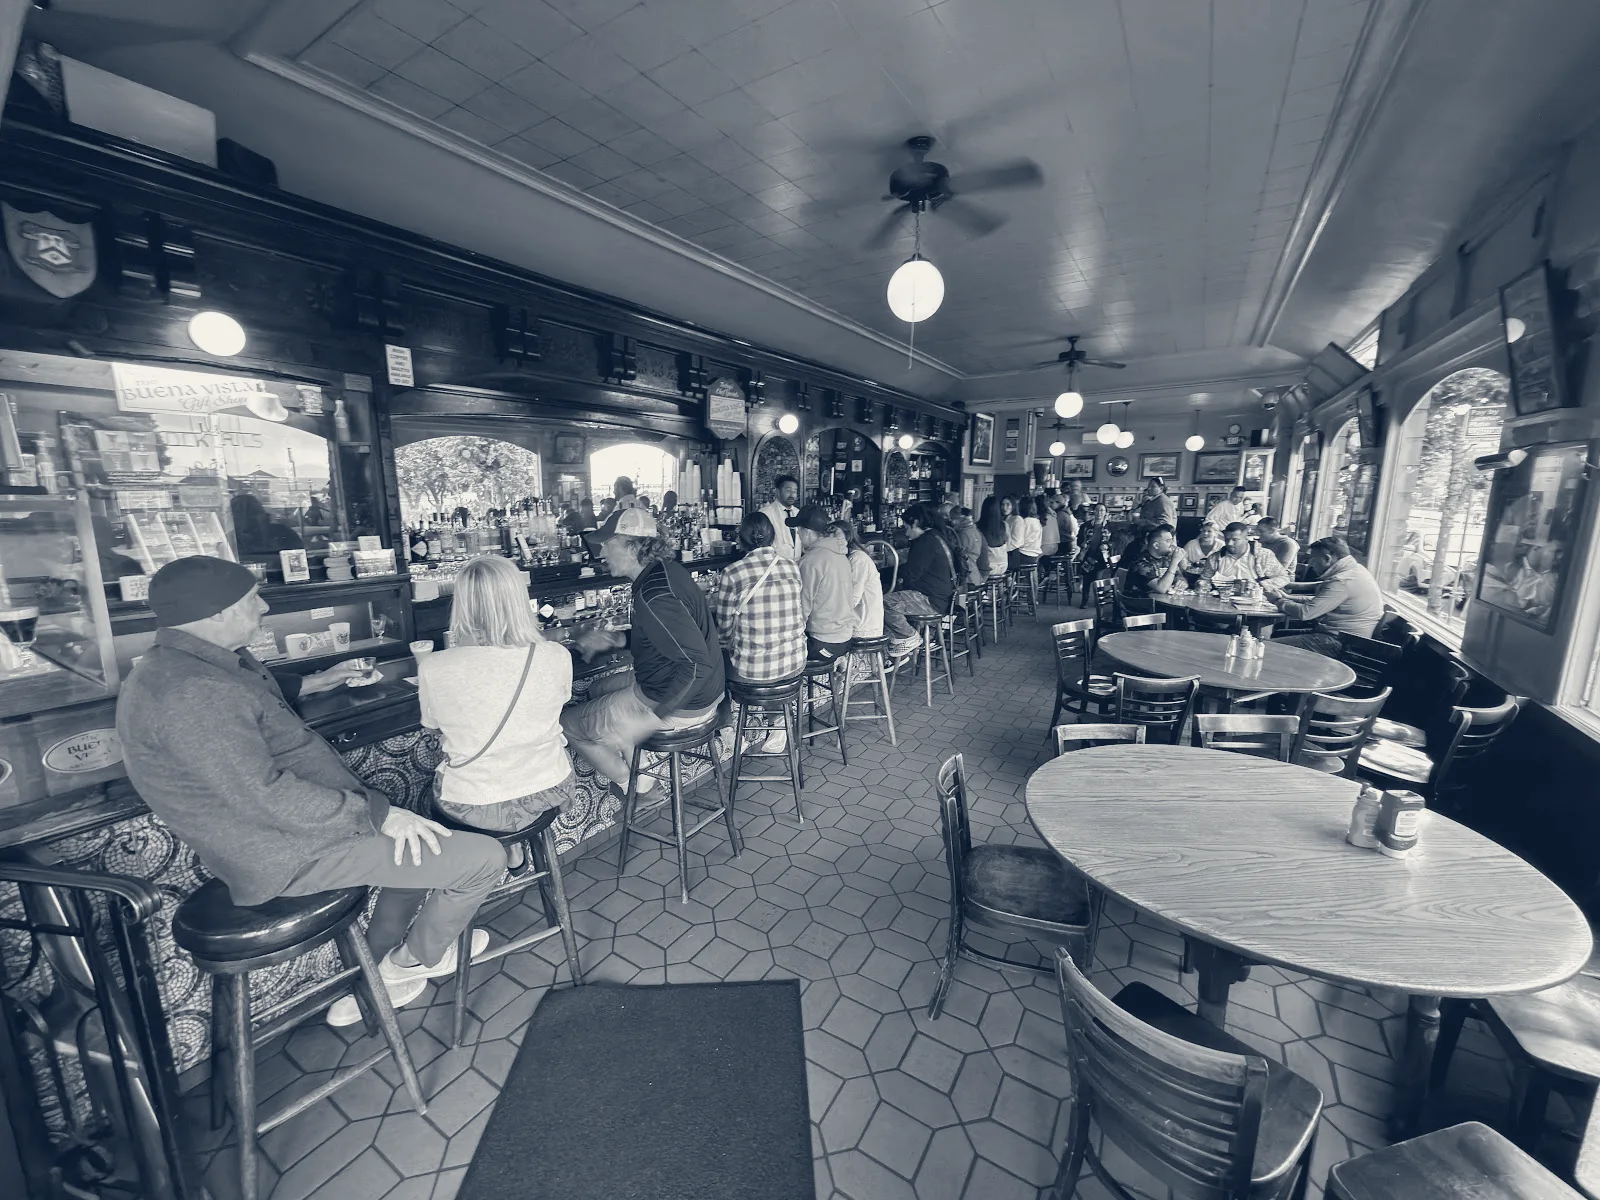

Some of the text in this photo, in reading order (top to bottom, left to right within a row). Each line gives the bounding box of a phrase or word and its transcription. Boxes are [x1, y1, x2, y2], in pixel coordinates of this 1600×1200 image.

[120, 381, 254, 401] BUENA VISTA
[178, 396, 210, 412] Gift
[1471, 408, 1500, 417] Pay by
